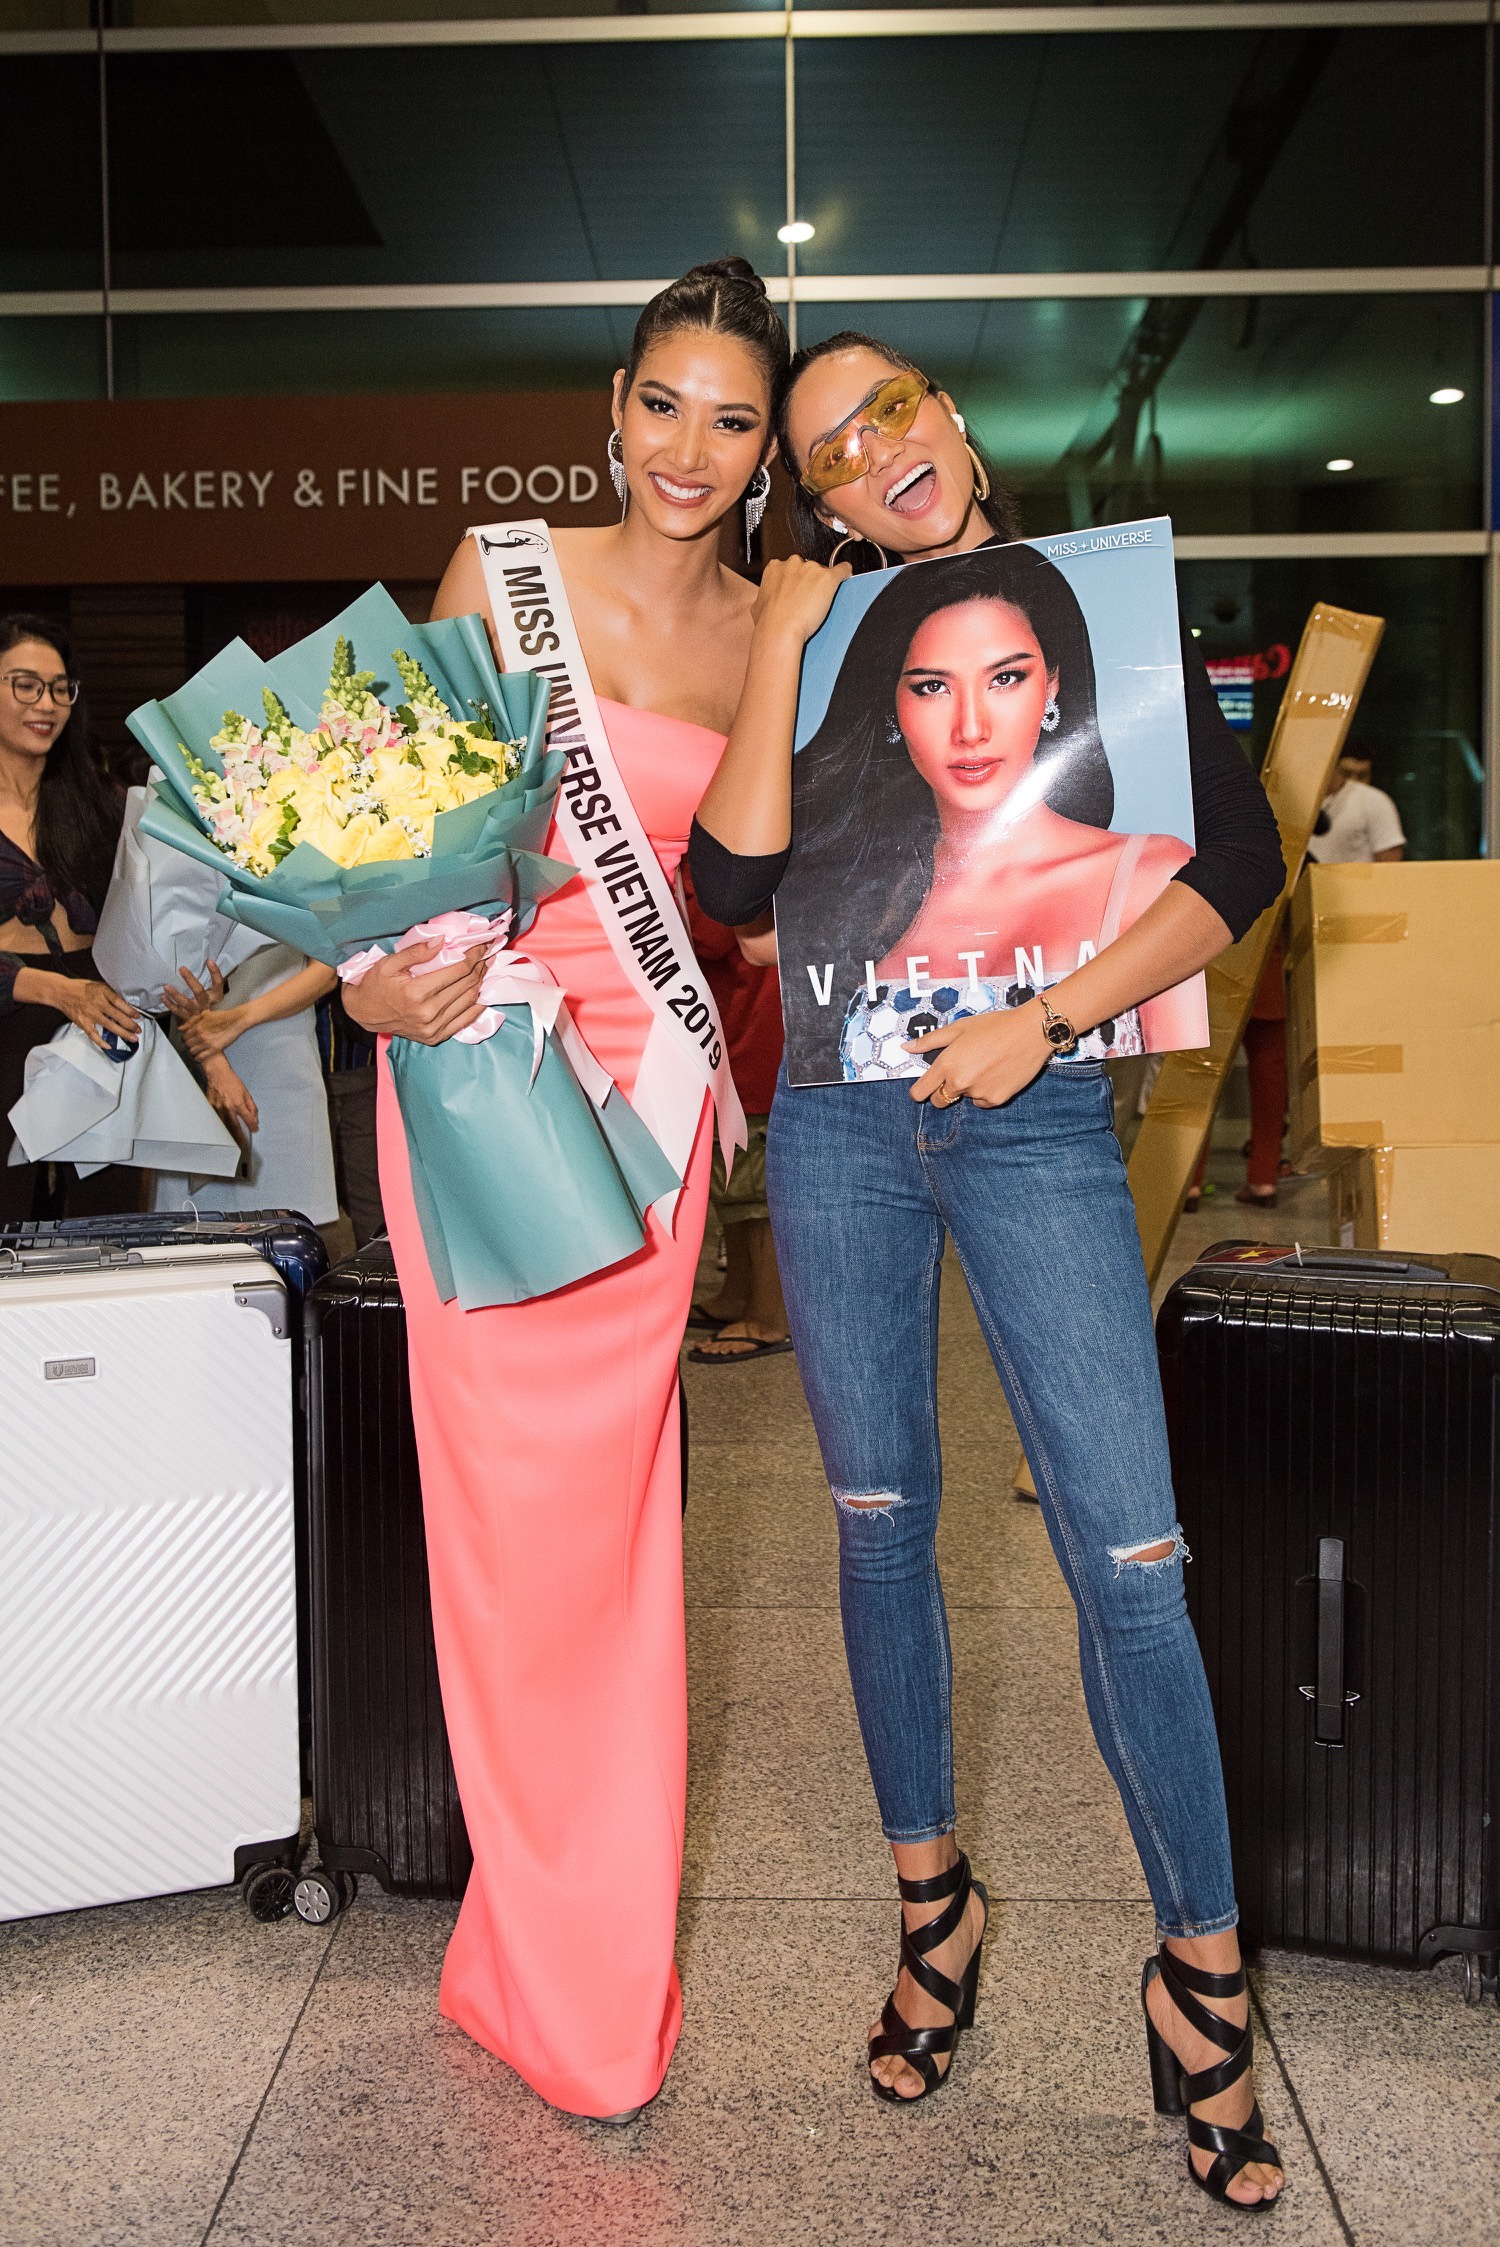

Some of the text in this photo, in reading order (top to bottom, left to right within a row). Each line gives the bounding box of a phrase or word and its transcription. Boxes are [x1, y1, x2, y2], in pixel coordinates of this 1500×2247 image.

[0, 464, 599, 519] EE, BAKERY & FINE FOOD
[1047, 529, 1153, 557] MISS UNIVERSE
[502, 565, 561, 656] MISS
[594, 839, 682, 991] VIETNAM
[666, 984, 722, 1071] 2019
[806, 940, 1100, 1006] VIETNA
